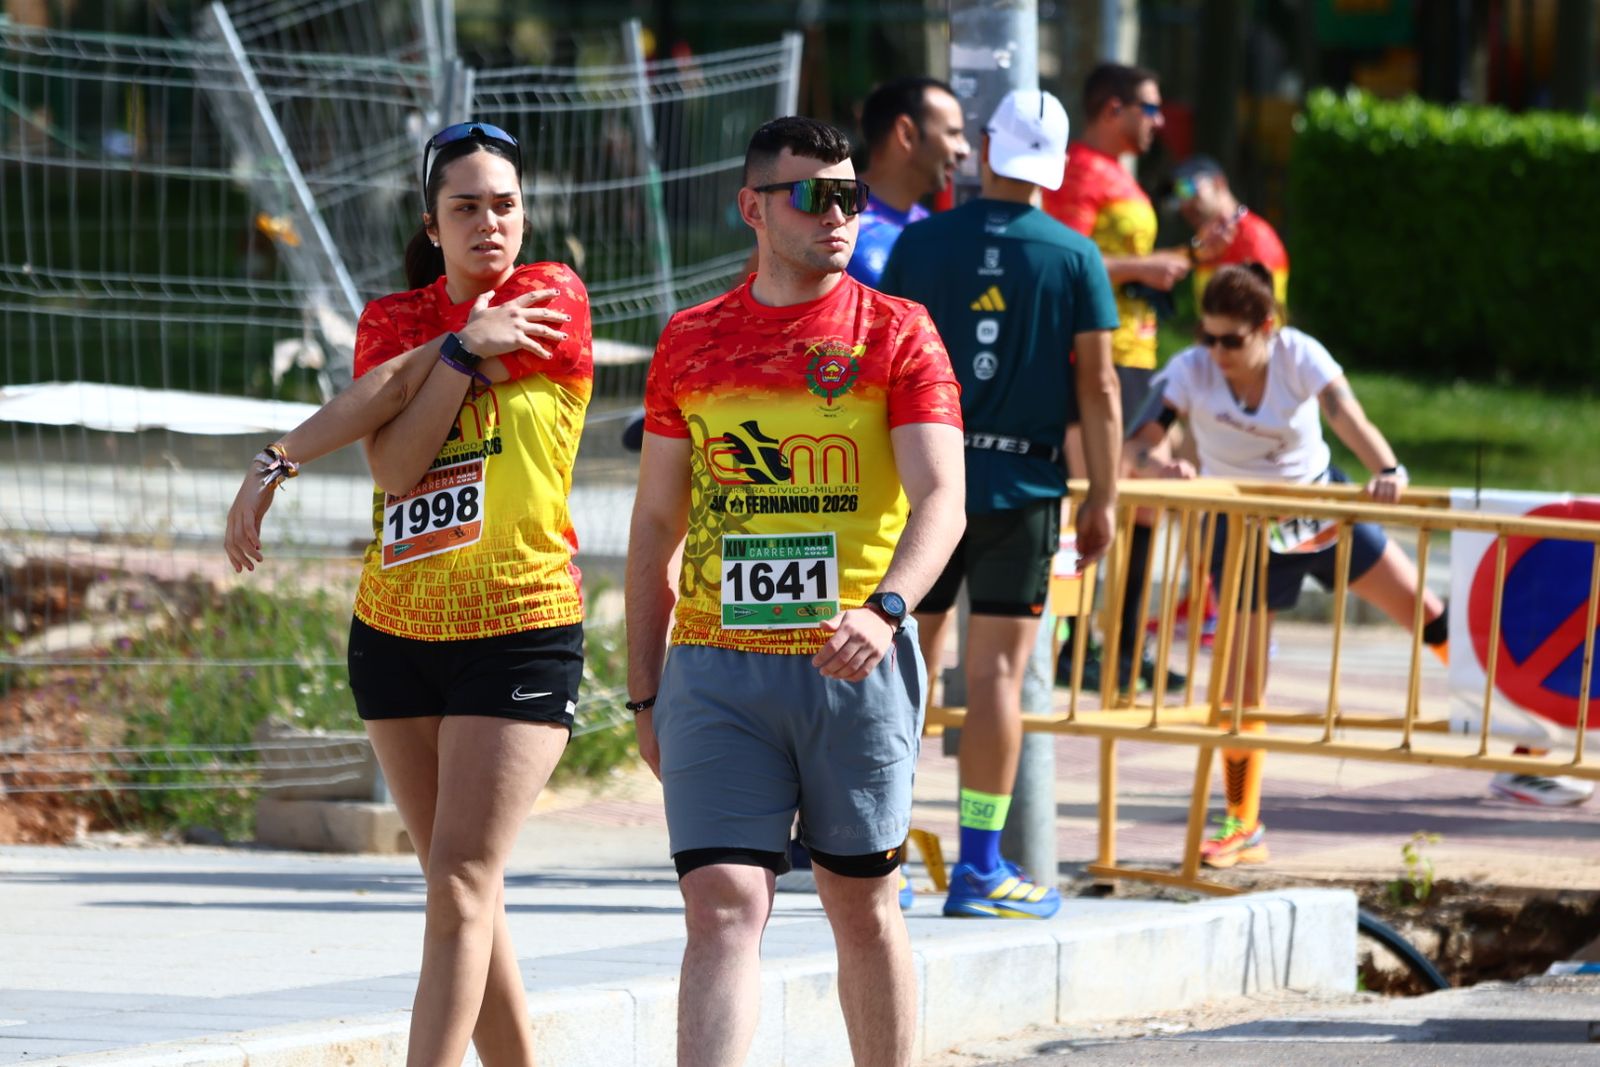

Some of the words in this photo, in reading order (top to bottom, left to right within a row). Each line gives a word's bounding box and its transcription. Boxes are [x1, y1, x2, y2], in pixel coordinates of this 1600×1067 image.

[964, 434, 1031, 454] ONE3
[389, 486, 479, 541] 1998
[746, 495, 819, 514] FERNANDO
[822, 494, 859, 513] 2026
[725, 539, 747, 557] XIV
[749, 547, 802, 558] CARRERA
[449, 583, 467, 596] POR
[726, 560, 828, 602] 1641
[457, 595, 483, 608] VALOR
[486, 592, 503, 605] POR
[411, 622, 442, 635] LEALTAD
[445, 623, 450, 634] Y
[454, 620, 481, 635] VALOR
[484, 619, 501, 632] POR
[505, 616, 515, 628] EL
[519, 607, 555, 624] TRABAJO
[447, 607, 482, 622] LEALTAD
[494, 602, 520, 616] VALOR
